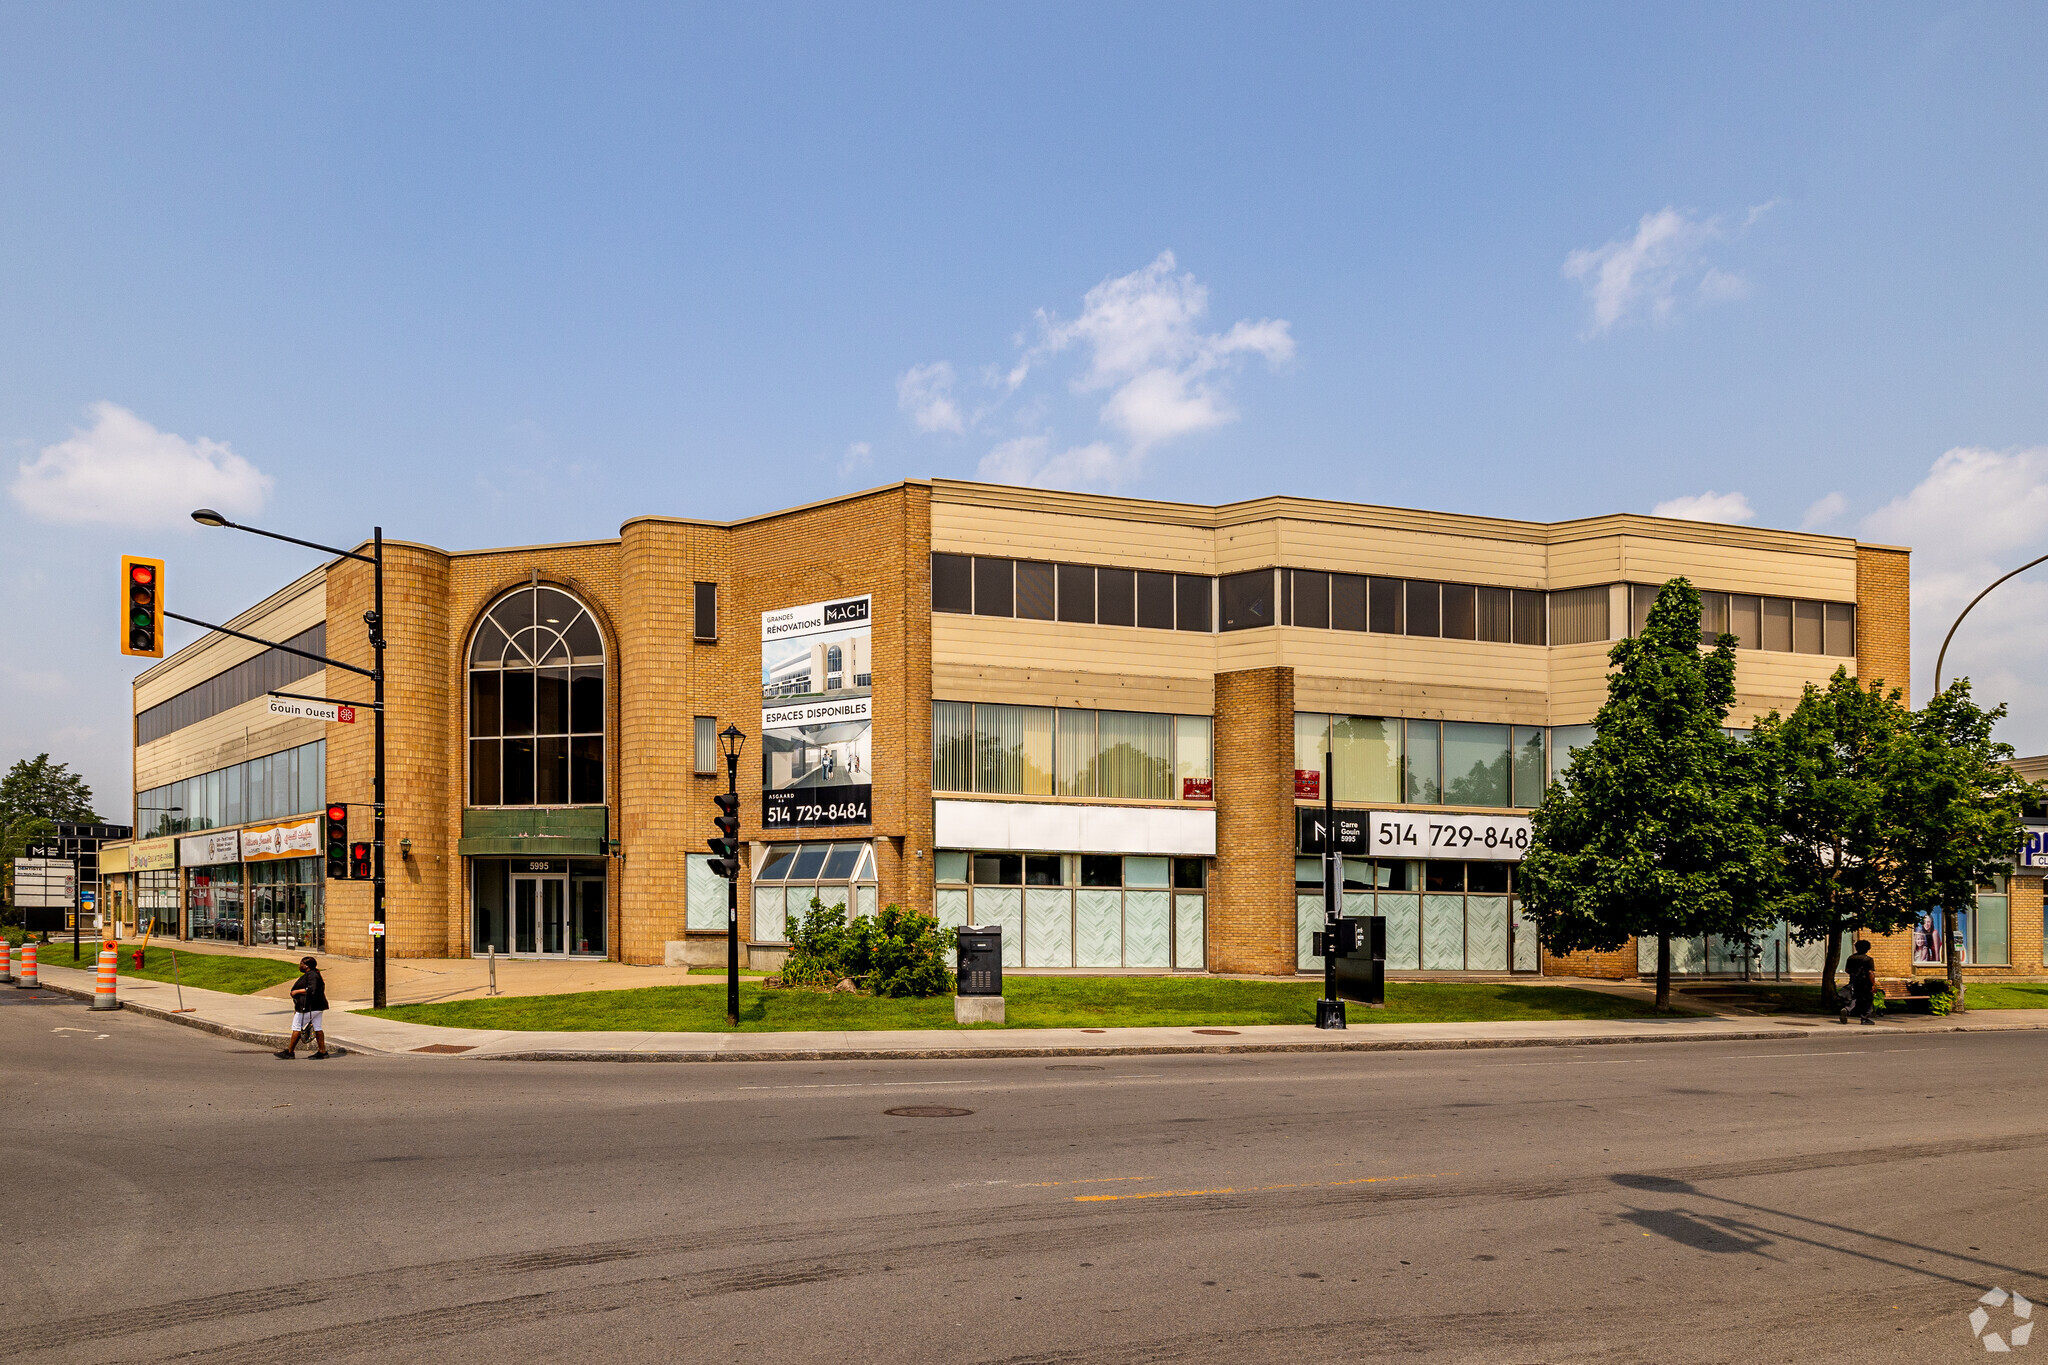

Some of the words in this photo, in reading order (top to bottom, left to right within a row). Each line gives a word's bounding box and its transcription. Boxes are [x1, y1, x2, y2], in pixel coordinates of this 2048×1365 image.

[766, 612, 794, 624] GRANDES
[827, 603, 866, 621] MACH
[766, 618, 821, 634] RÉNOVATIONS
[270, 703, 301, 715] Gouin
[305, 708, 335, 719] Ouest
[766, 710, 804, 723] ESPACES
[807, 703, 867, 719] DISPONIBLES
[767, 806, 791, 822] 514
[795, 802, 867, 821] 729-8484
[1340, 828, 1361, 836] Gouin
[1340, 835, 1357, 843] 5995
[1378, 822, 1417, 846] 514
[1429, 825, 1529, 849] 729-848
[529, 861, 549, 871] 5995
